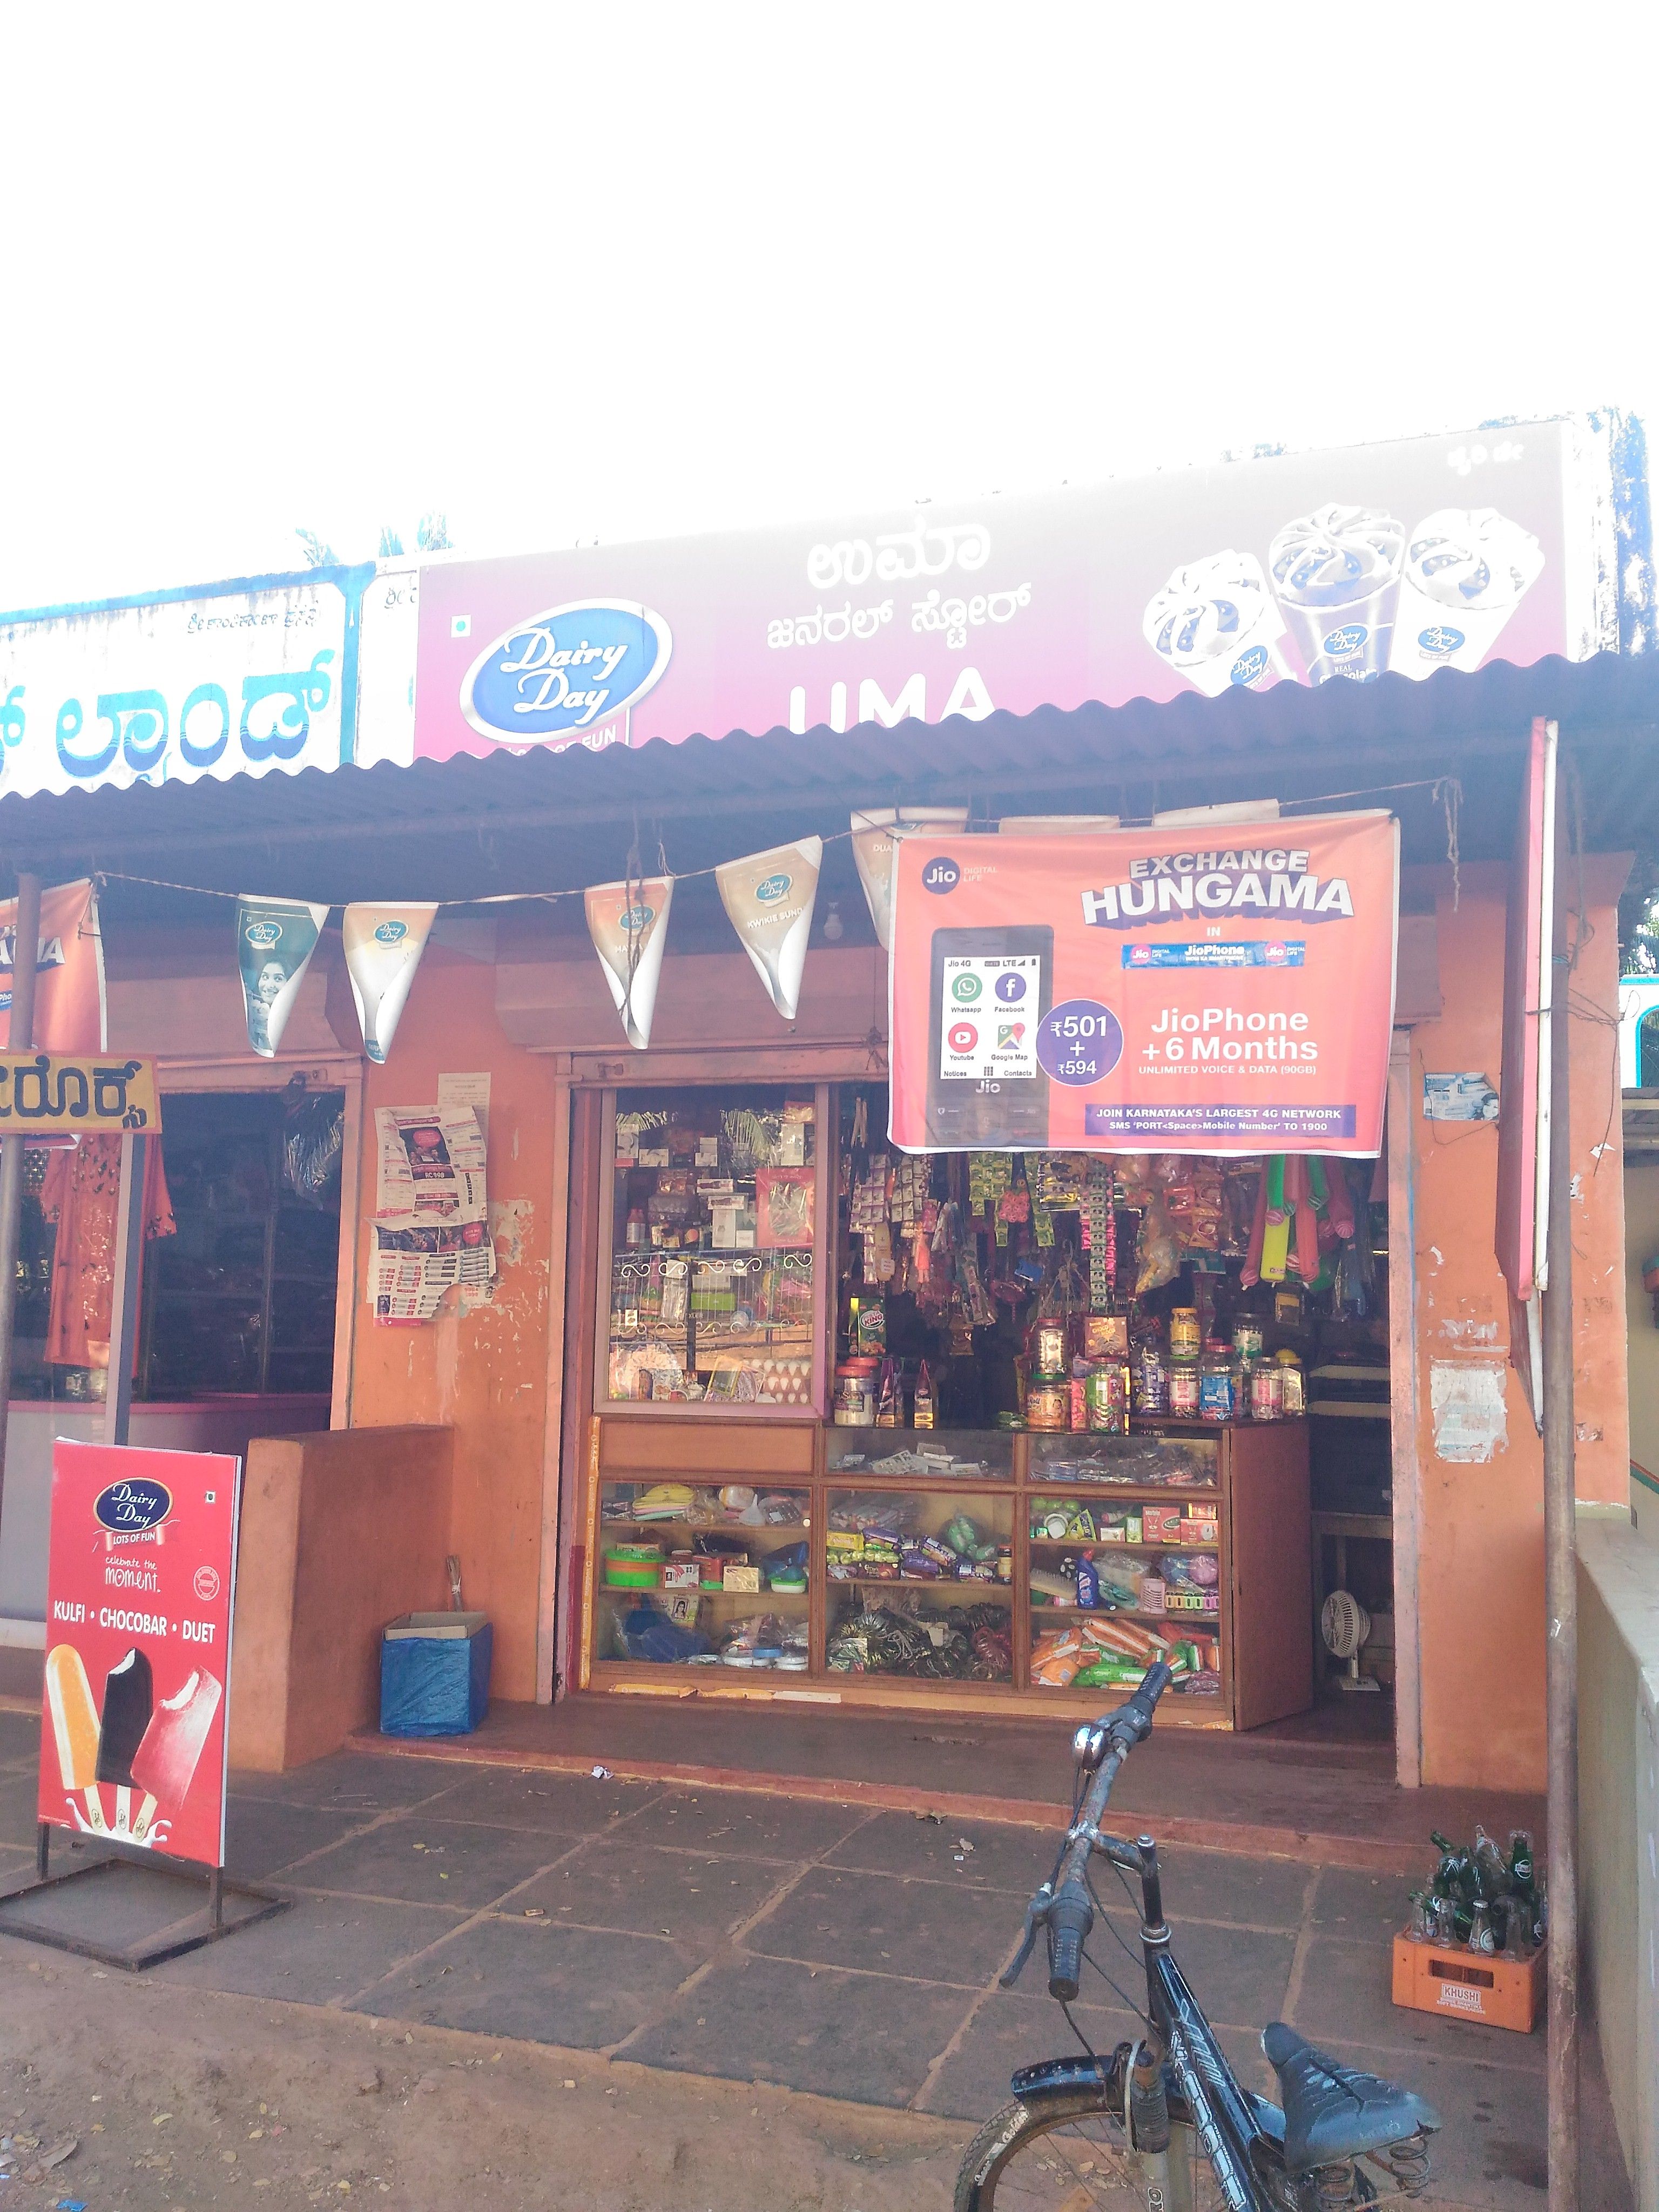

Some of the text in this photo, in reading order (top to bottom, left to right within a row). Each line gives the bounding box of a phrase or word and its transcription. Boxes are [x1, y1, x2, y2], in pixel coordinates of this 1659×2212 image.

[806, 515, 992, 589] ಉಮಾ
[766, 582, 1033, 650] ಜನರಲ್ ಸ್ಟೋರ್
[500, 626, 628, 682] Dairy
[514, 667, 611, 725] Day
[789, 666, 996, 734] UMA
[964, 866, 998, 875] DIGITAL
[1129, 849, 1310, 879] EXCHANGE
[926, 866, 956, 884] Jio
[760, 880, 785, 891] Dairy
[765, 887, 783, 897] Day
[1081, 873, 1354, 925] HUNGAMA
[625, 909, 648, 919] Daiy
[747, 914, 779, 928] KWIKIE
[253, 924, 276, 936] Dairy
[380, 923, 401, 934] Dairy
[1206, 927, 1221, 936] IN
[255, 932, 273, 943] Day
[382, 931, 398, 941] Day
[1132, 949, 1149, 959] Jio
[1184, 945, 1245, 956] JioPhone
[1266, 946, 1284, 957] Jio
[1003, 959, 1016, 967] LTE
[1050, 1015, 1108, 1037] ₹501
[1151, 1007, 1309, 1033] JioPhone
[1191, 1035, 1319, 1061] Months
[1057, 1060, 1097, 1075] ₹594
[1138, 1065, 1317, 1076] UNLIMITED VOICE & DATA (90GB)
[975, 1079, 1001, 1094] Jio
[1096, 1109, 1341, 1119] JOIN KARNATAKA'S LARGEST 4G NETWORK
[1109, 1122, 1130, 1130] SMS
[864, 1314, 882, 1326] KING
[111, 1483, 158, 1510] Dairy
[116, 1503, 151, 1529] Day
[113, 1532, 156, 1545] LOTS OF FUN
[105, 1555, 157, 1570] celebrate the
[53, 1600, 216, 1644] KULFI CHOCOBAR DUET
[1444, 1986, 1479, 2002] KHUSHI
